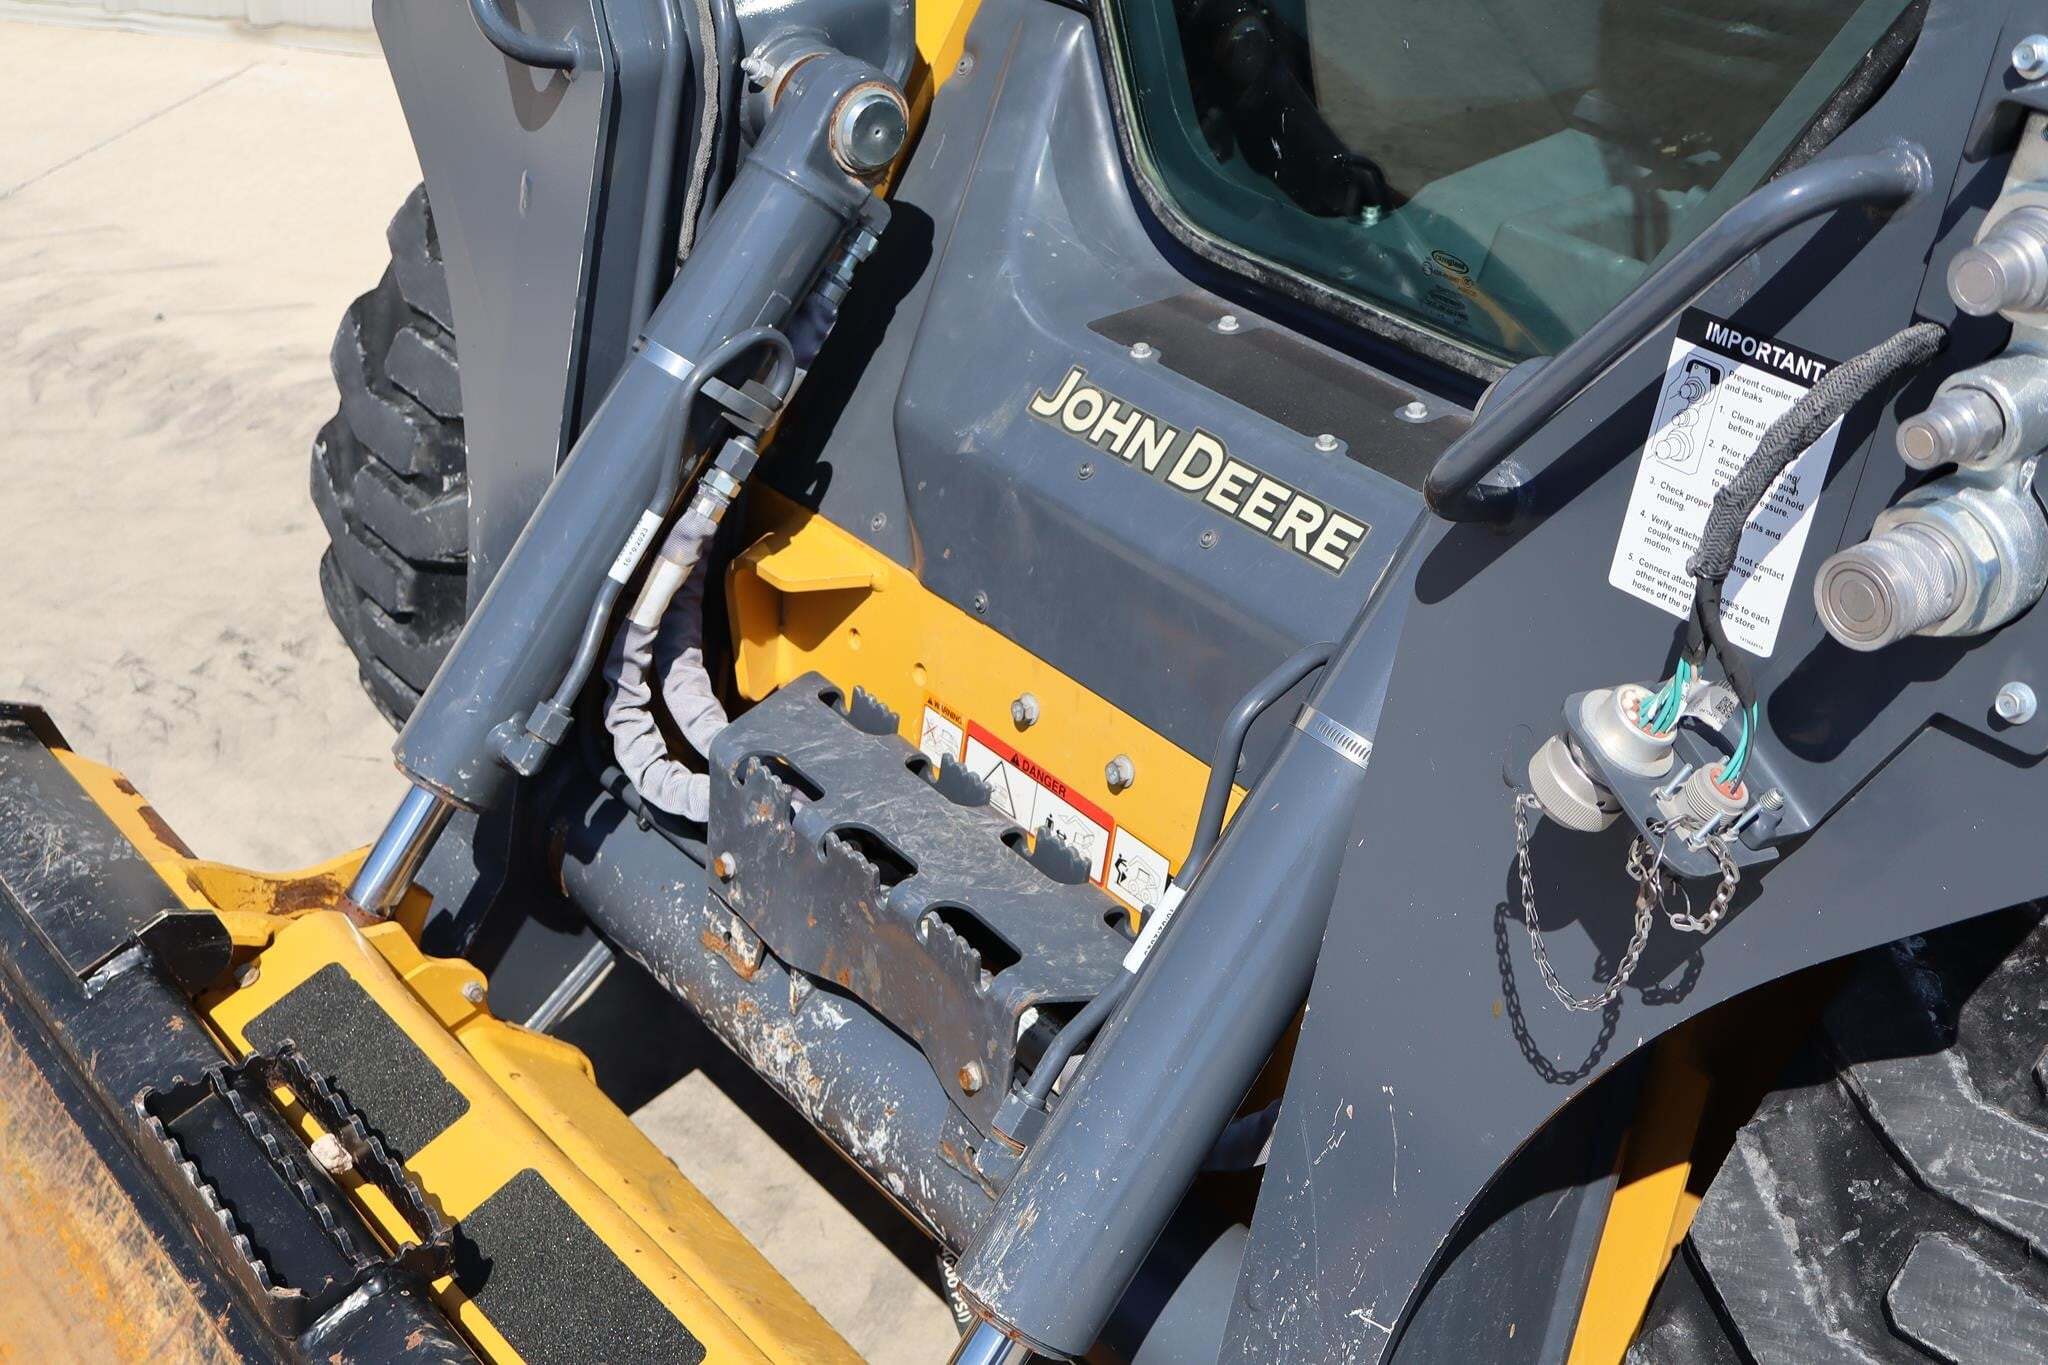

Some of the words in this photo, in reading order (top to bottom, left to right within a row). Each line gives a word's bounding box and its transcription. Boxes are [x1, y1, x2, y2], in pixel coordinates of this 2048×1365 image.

[1704, 320, 1827, 384] IMPORTANT
[1724, 382, 1740, 395] and
[1741, 388, 1763, 403] leaks
[1728, 370, 1760, 389] Prevent
[1760, 384, 1792, 401] coupler
[1727, 421, 1754, 438] before
[1731, 410, 1754, 426] Clean
[1755, 421, 1767, 431] all
[1708, 439, 1715, 448] 2.
[1720, 444, 1741, 457] Prior
[1030, 369, 1177, 472] JOHN
[1166, 431, 1365, 571] DEERE
[1714, 468, 1736, 482] coup
[1649, 476, 1656, 486] 3.
[1660, 481, 1684, 498] Check
[1685, 493, 1712, 510] proper
[1765, 527, 1782, 540] and
[1656, 492, 1686, 512] routing.
[1711, 478, 1720, 488] to
[1785, 495, 1805, 512] hold
[1640, 509, 1647, 518] 4.
[1651, 513, 1673, 531] Verify
[1739, 554, 1753, 567] not
[1754, 561, 1785, 582] contact
[1643, 536, 1673, 555] motion.
[1647, 526, 1681, 546] couplers
[1752, 574, 1762, 583] of
[1627, 552, 1634, 562] 5.
[1638, 557, 1671, 578] Connect
[1741, 605, 1750, 615] to
[1750, 611, 1771, 625] each
[1635, 569, 1656, 583] other
[1657, 580, 1678, 594] when
[1678, 590, 1692, 601] not
[1631, 578, 1655, 596] hoses
[1656, 592, 1668, 601] off
[1668, 596, 1681, 608] the
[1734, 616, 1756, 631] store
[1022, 759, 1067, 798] DANGER
